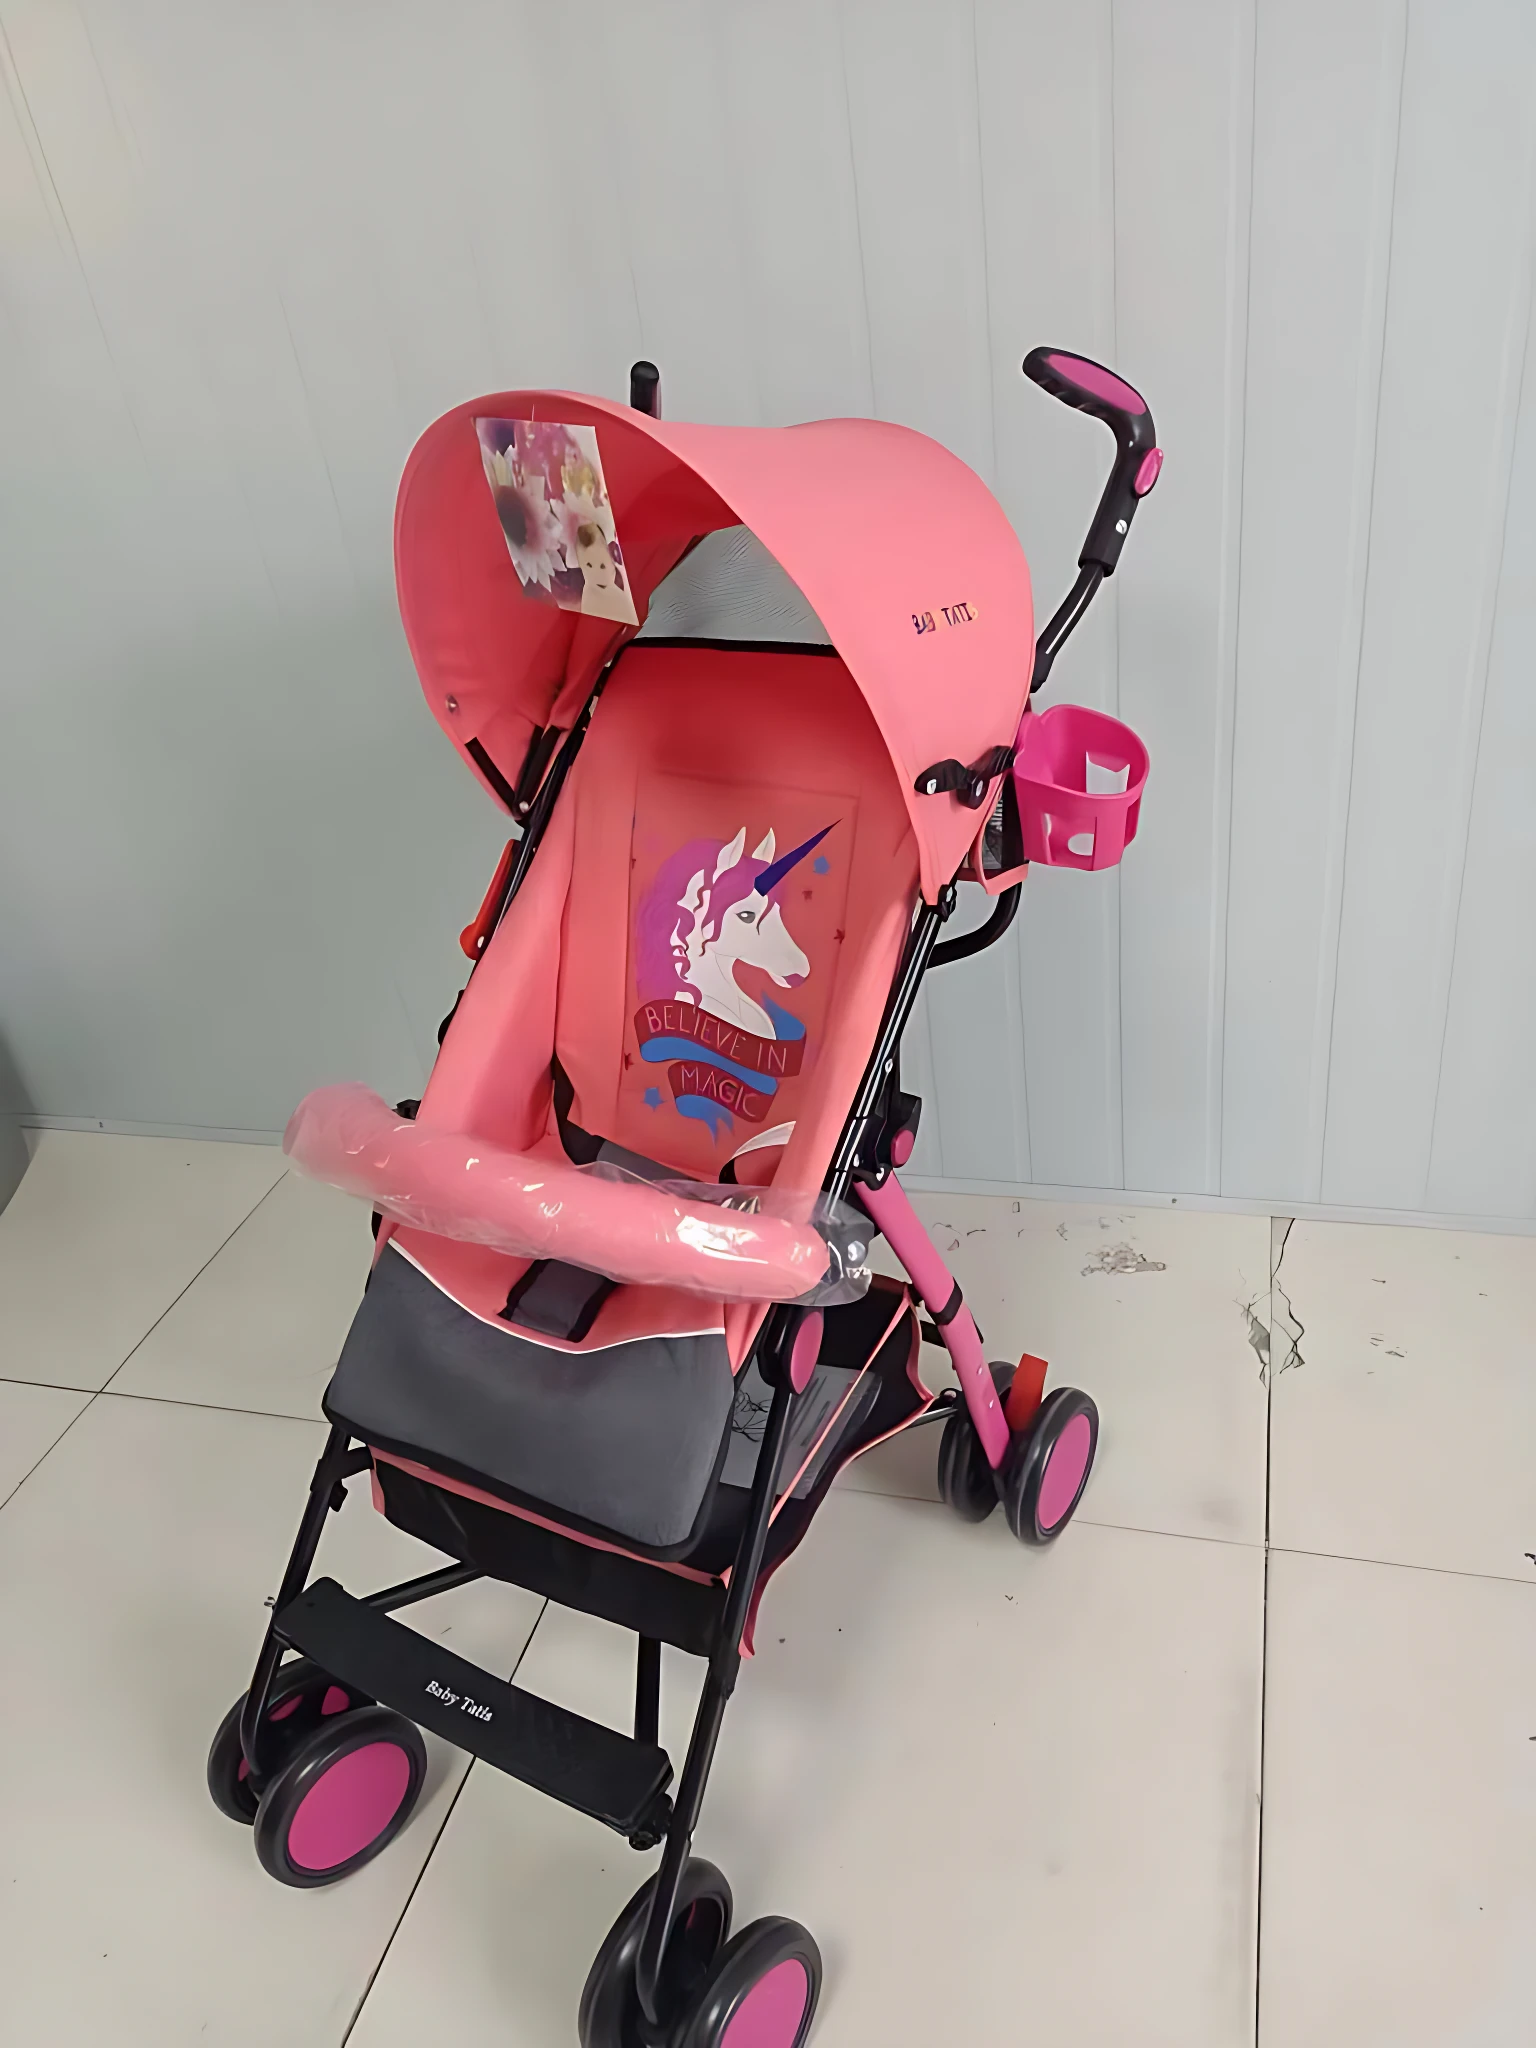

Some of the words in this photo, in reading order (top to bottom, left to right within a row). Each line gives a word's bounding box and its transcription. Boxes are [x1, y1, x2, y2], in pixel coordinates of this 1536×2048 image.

[644, 1004, 747, 1060] BELIEVE
[757, 1042, 787, 1074] IN
[680, 1064, 758, 1118] MAGIC
[425, 1680, 460, 1706] Baby
